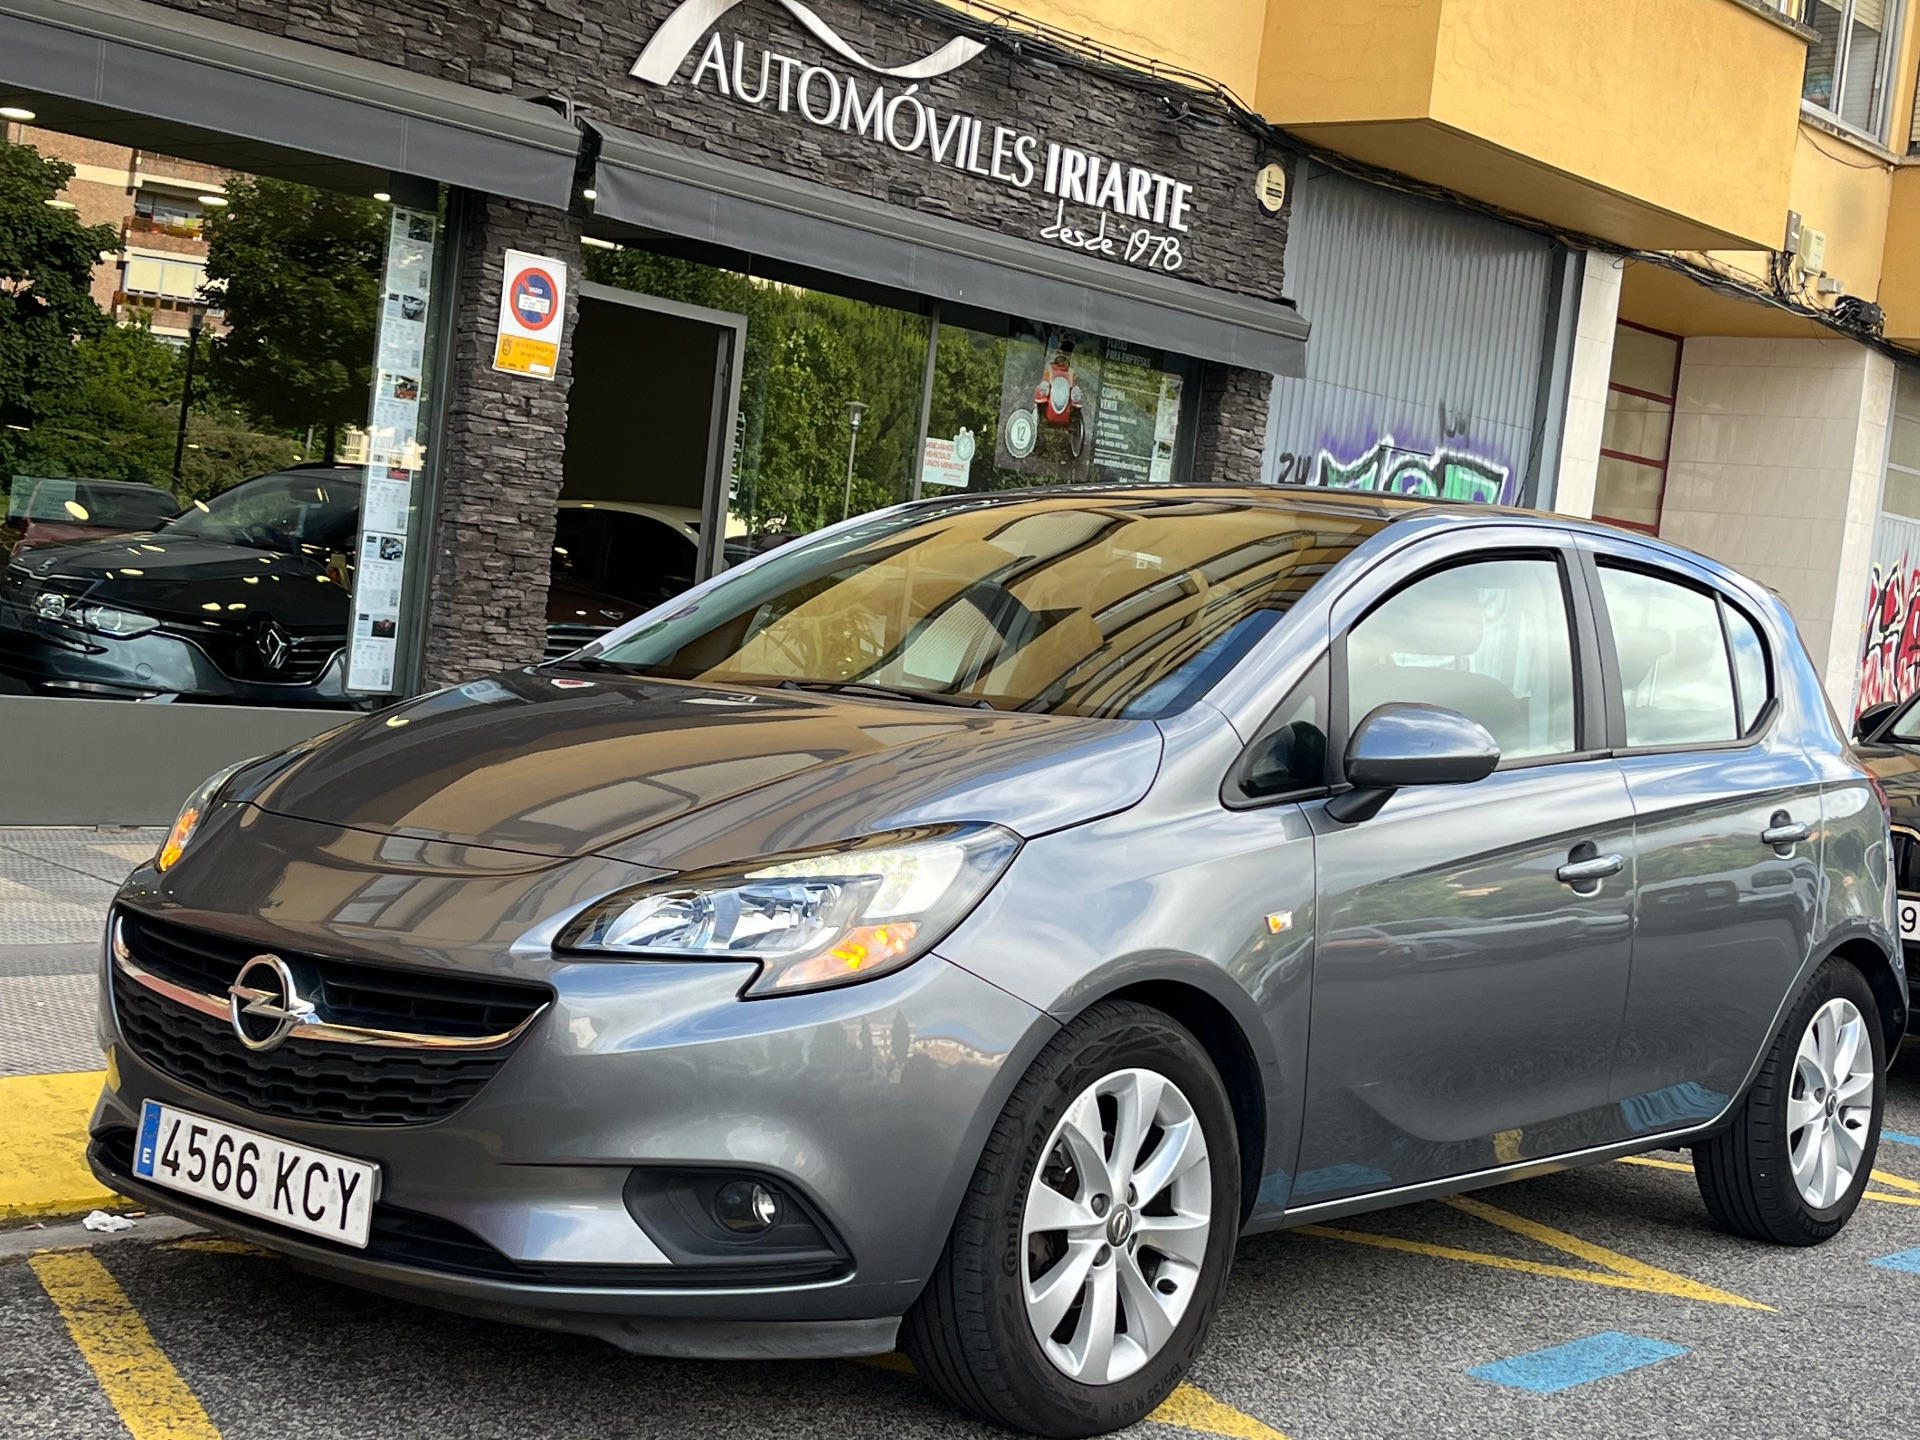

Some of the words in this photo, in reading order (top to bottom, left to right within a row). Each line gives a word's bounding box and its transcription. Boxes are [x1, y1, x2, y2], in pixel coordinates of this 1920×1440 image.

[690, 31, 1038, 189] AUTOMÓVILES
[1044, 142, 1194, 233] IRIARTE
[1039, 199, 1117, 256] desde
[1123, 228, 1183, 272] 1978
[1121, 352, 1151, 369] EMPRESAS
[1017, 426, 1026, 442] 12
[140, 1147, 151, 1165] E
[160, 1118, 261, 1201] 4566
[272, 1150, 362, 1231] KCY
